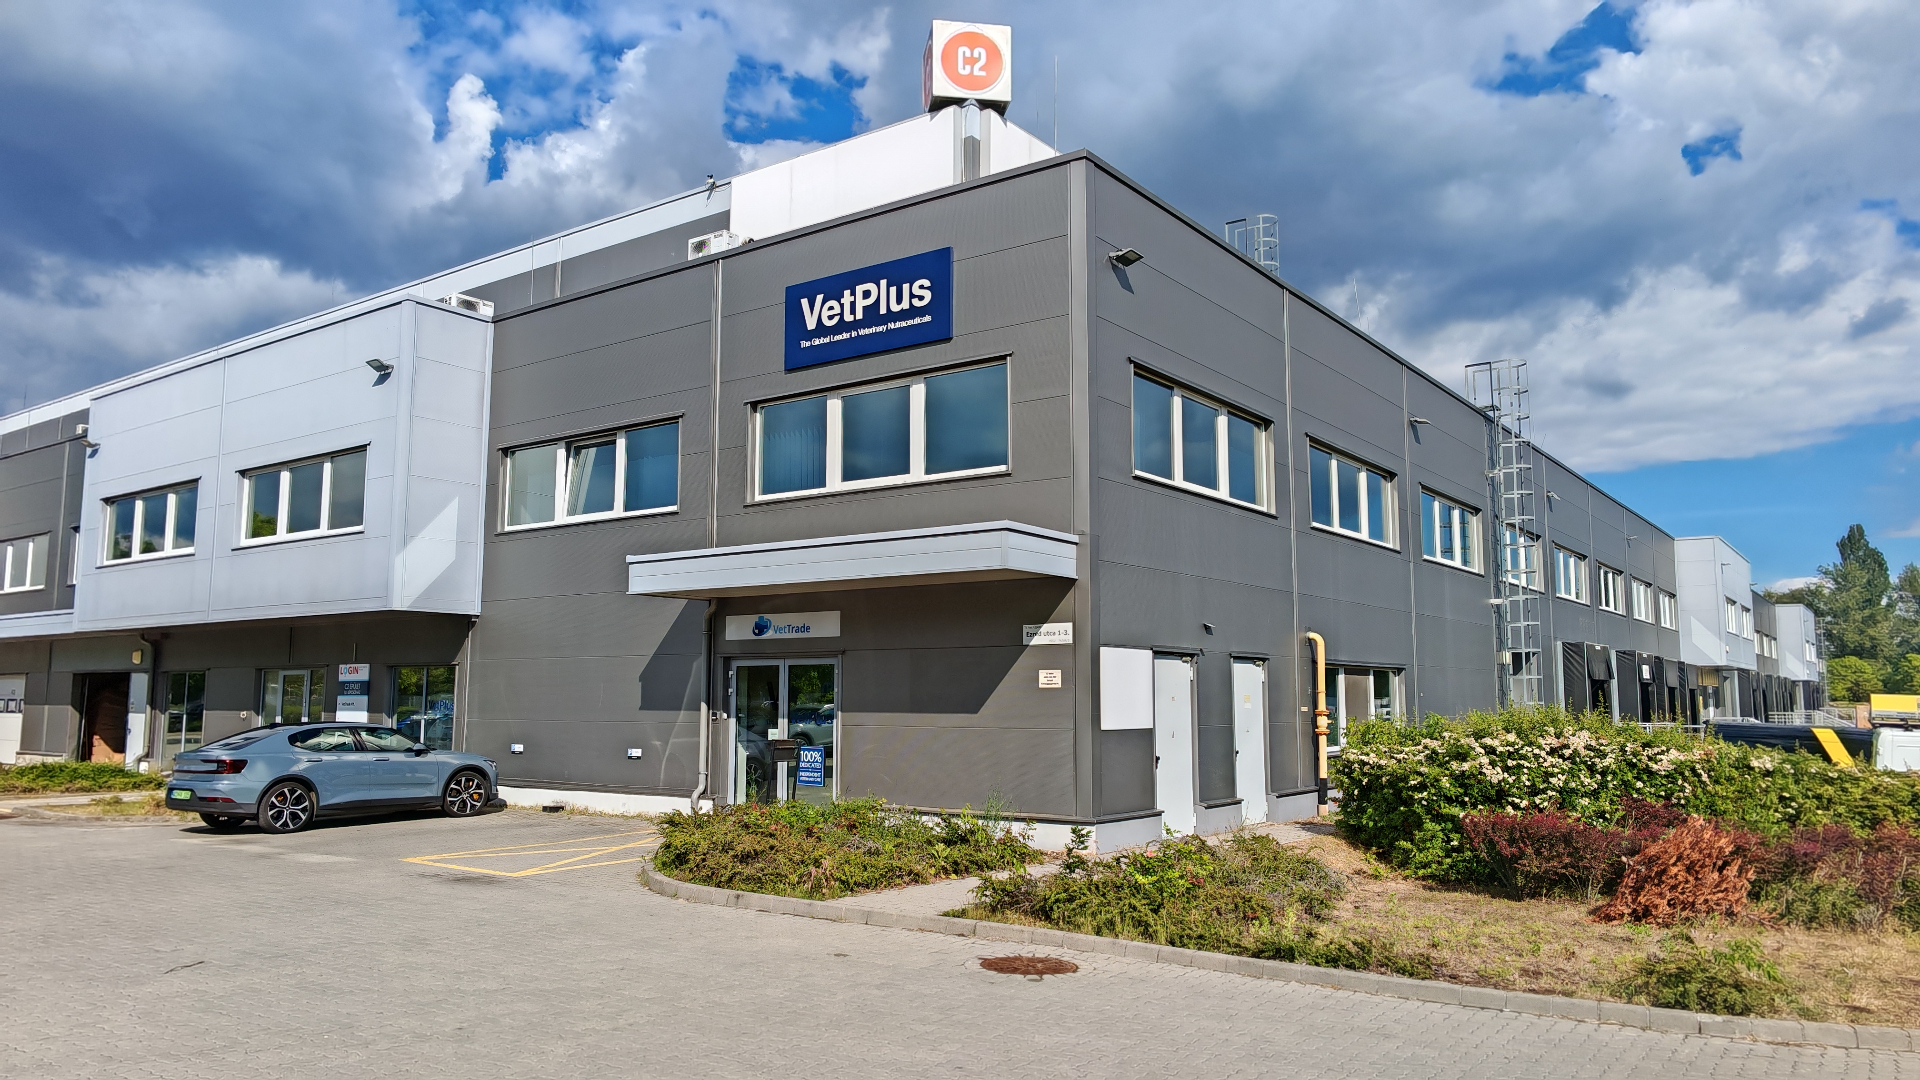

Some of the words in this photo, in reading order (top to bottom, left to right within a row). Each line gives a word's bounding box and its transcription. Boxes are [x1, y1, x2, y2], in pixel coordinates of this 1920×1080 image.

[957, 46, 987, 76] C2
[800, 278, 932, 331] VetPlus
[800, 340, 811, 348] The
[811, 335, 830, 346] Global
[830, 331, 851, 342] Leader
[851, 329, 858, 338] in
[858, 323, 887, 336] Veterinary
[887, 314, 932, 330] Nutraceuticals
[773, 622, 811, 635] VetTrade
[340, 666, 359, 676] LOGIN
[800, 750, 822, 763] 100%
